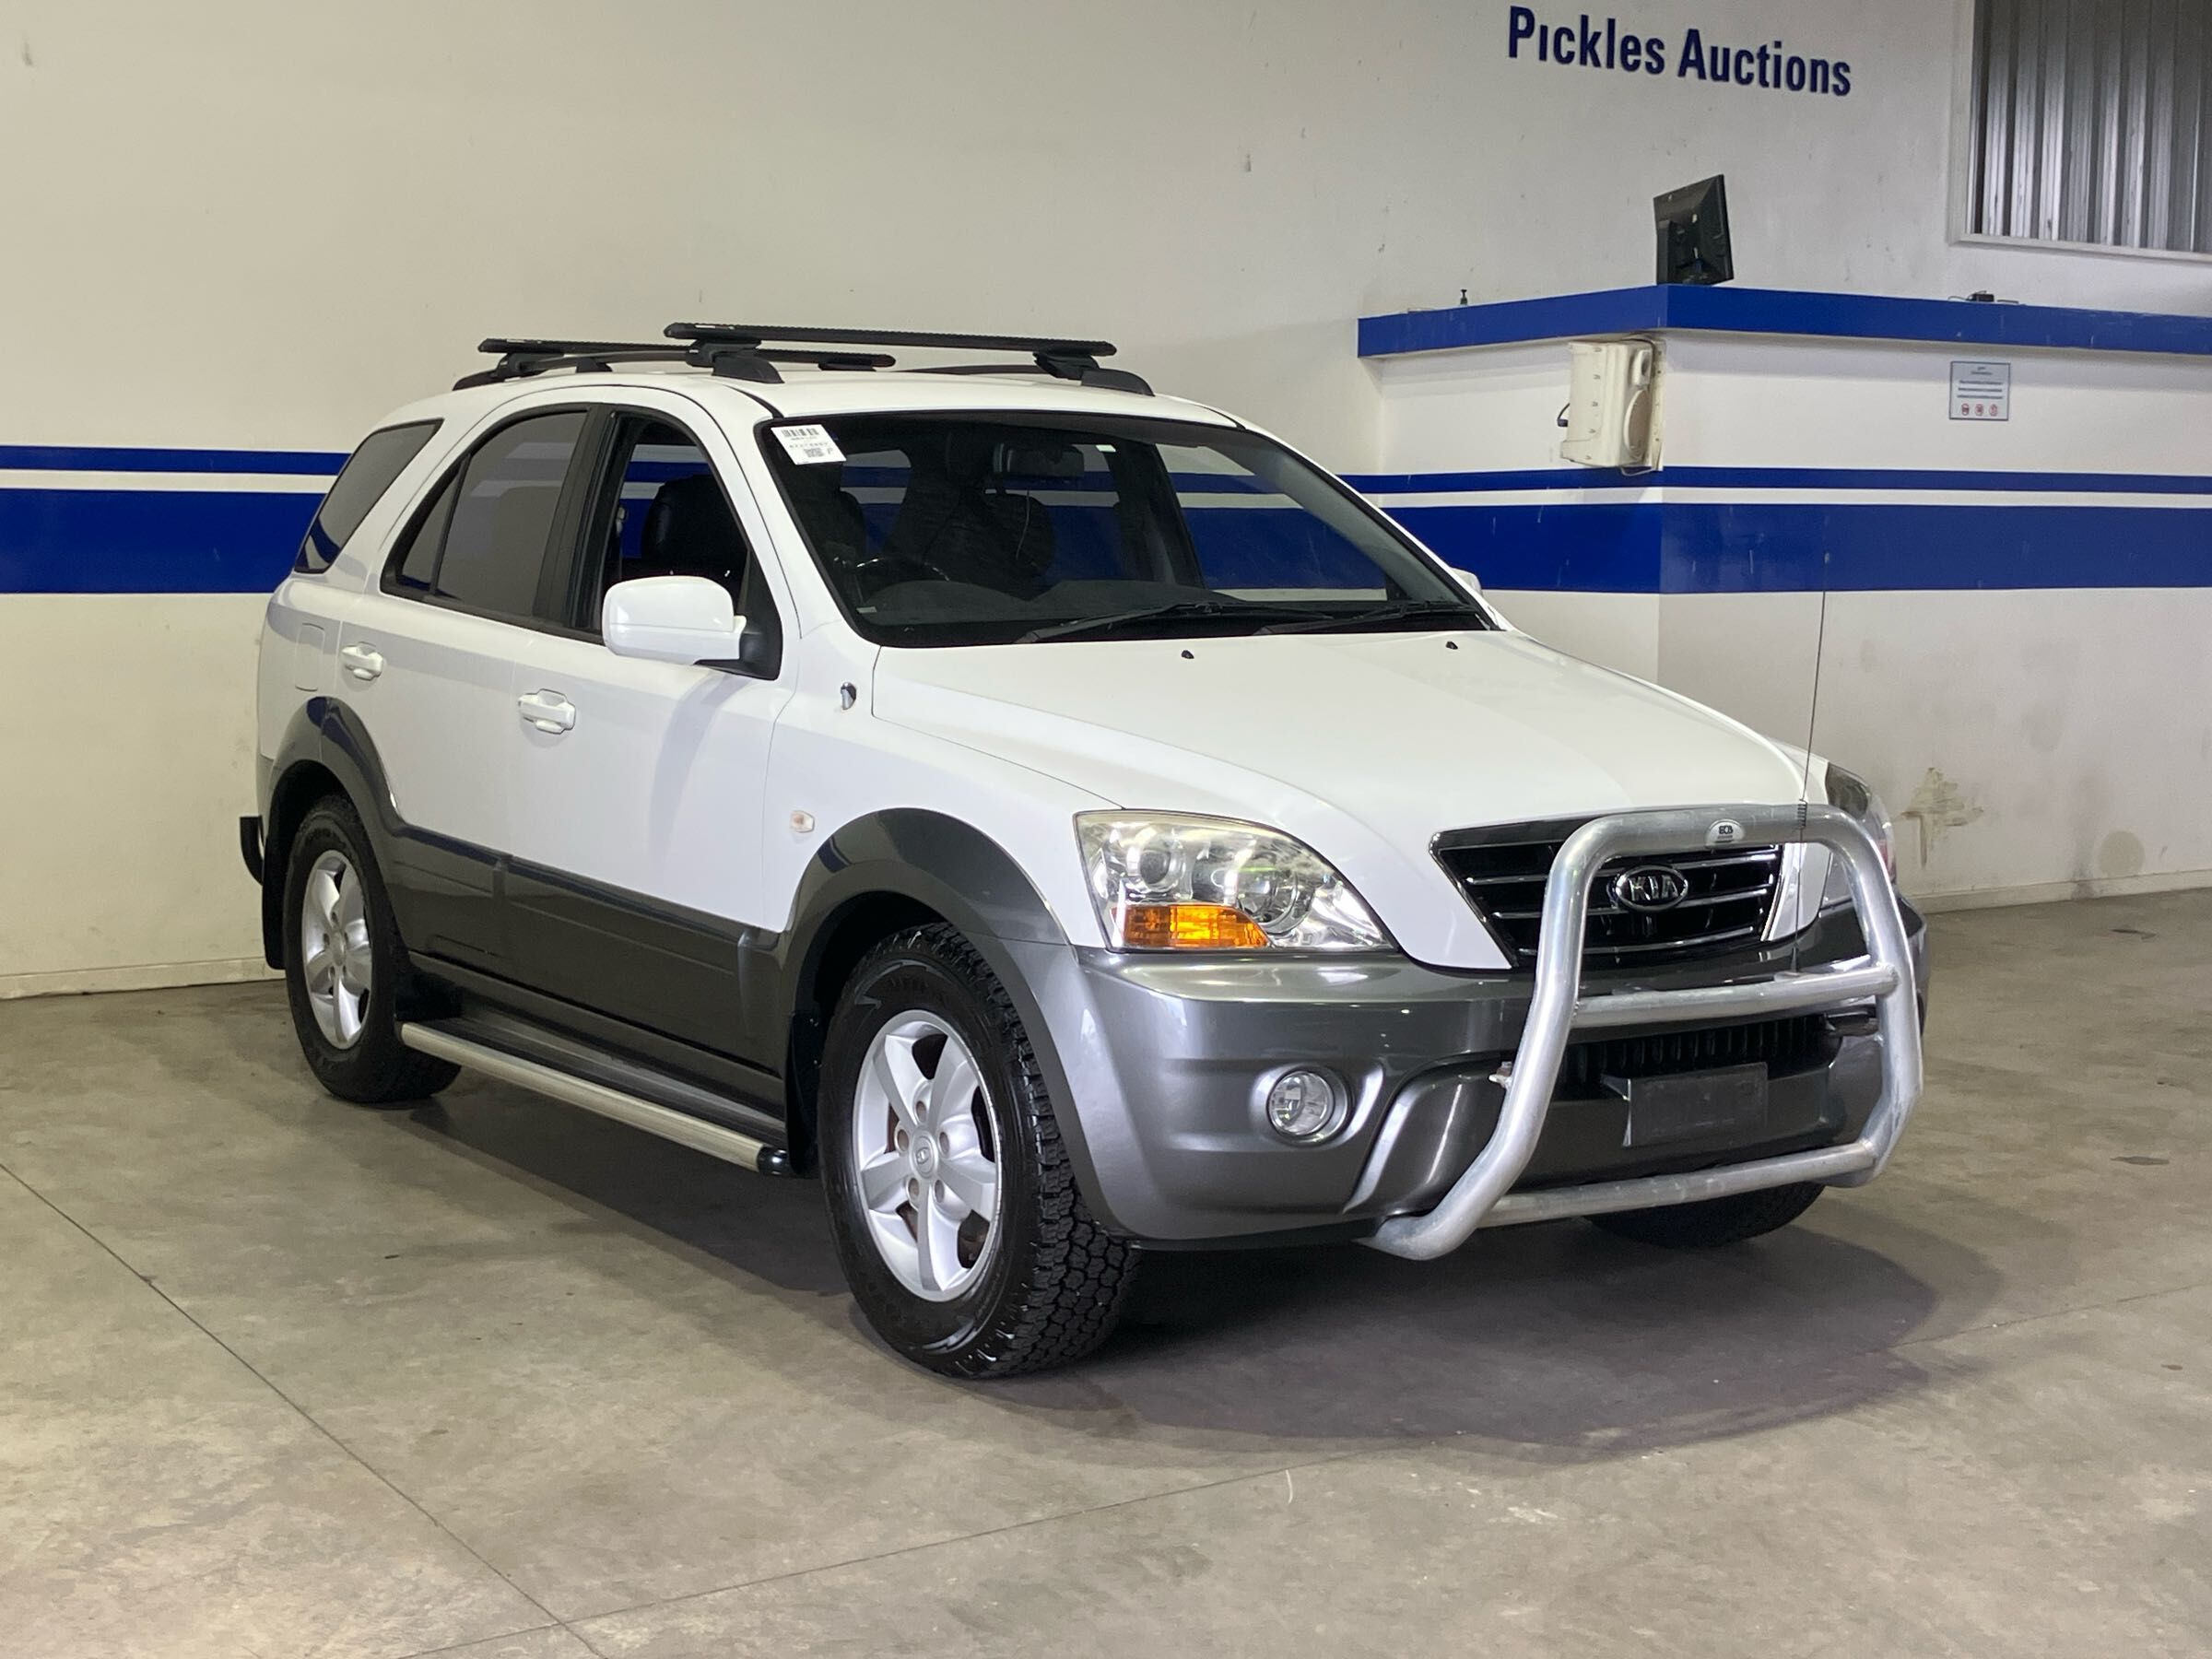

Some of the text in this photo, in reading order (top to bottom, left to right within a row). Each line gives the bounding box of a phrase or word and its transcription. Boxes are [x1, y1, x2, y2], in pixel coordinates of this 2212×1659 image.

[1508, 6, 1851, 97] Pickles Auctions
[1627, 875, 1679, 901] KIA
